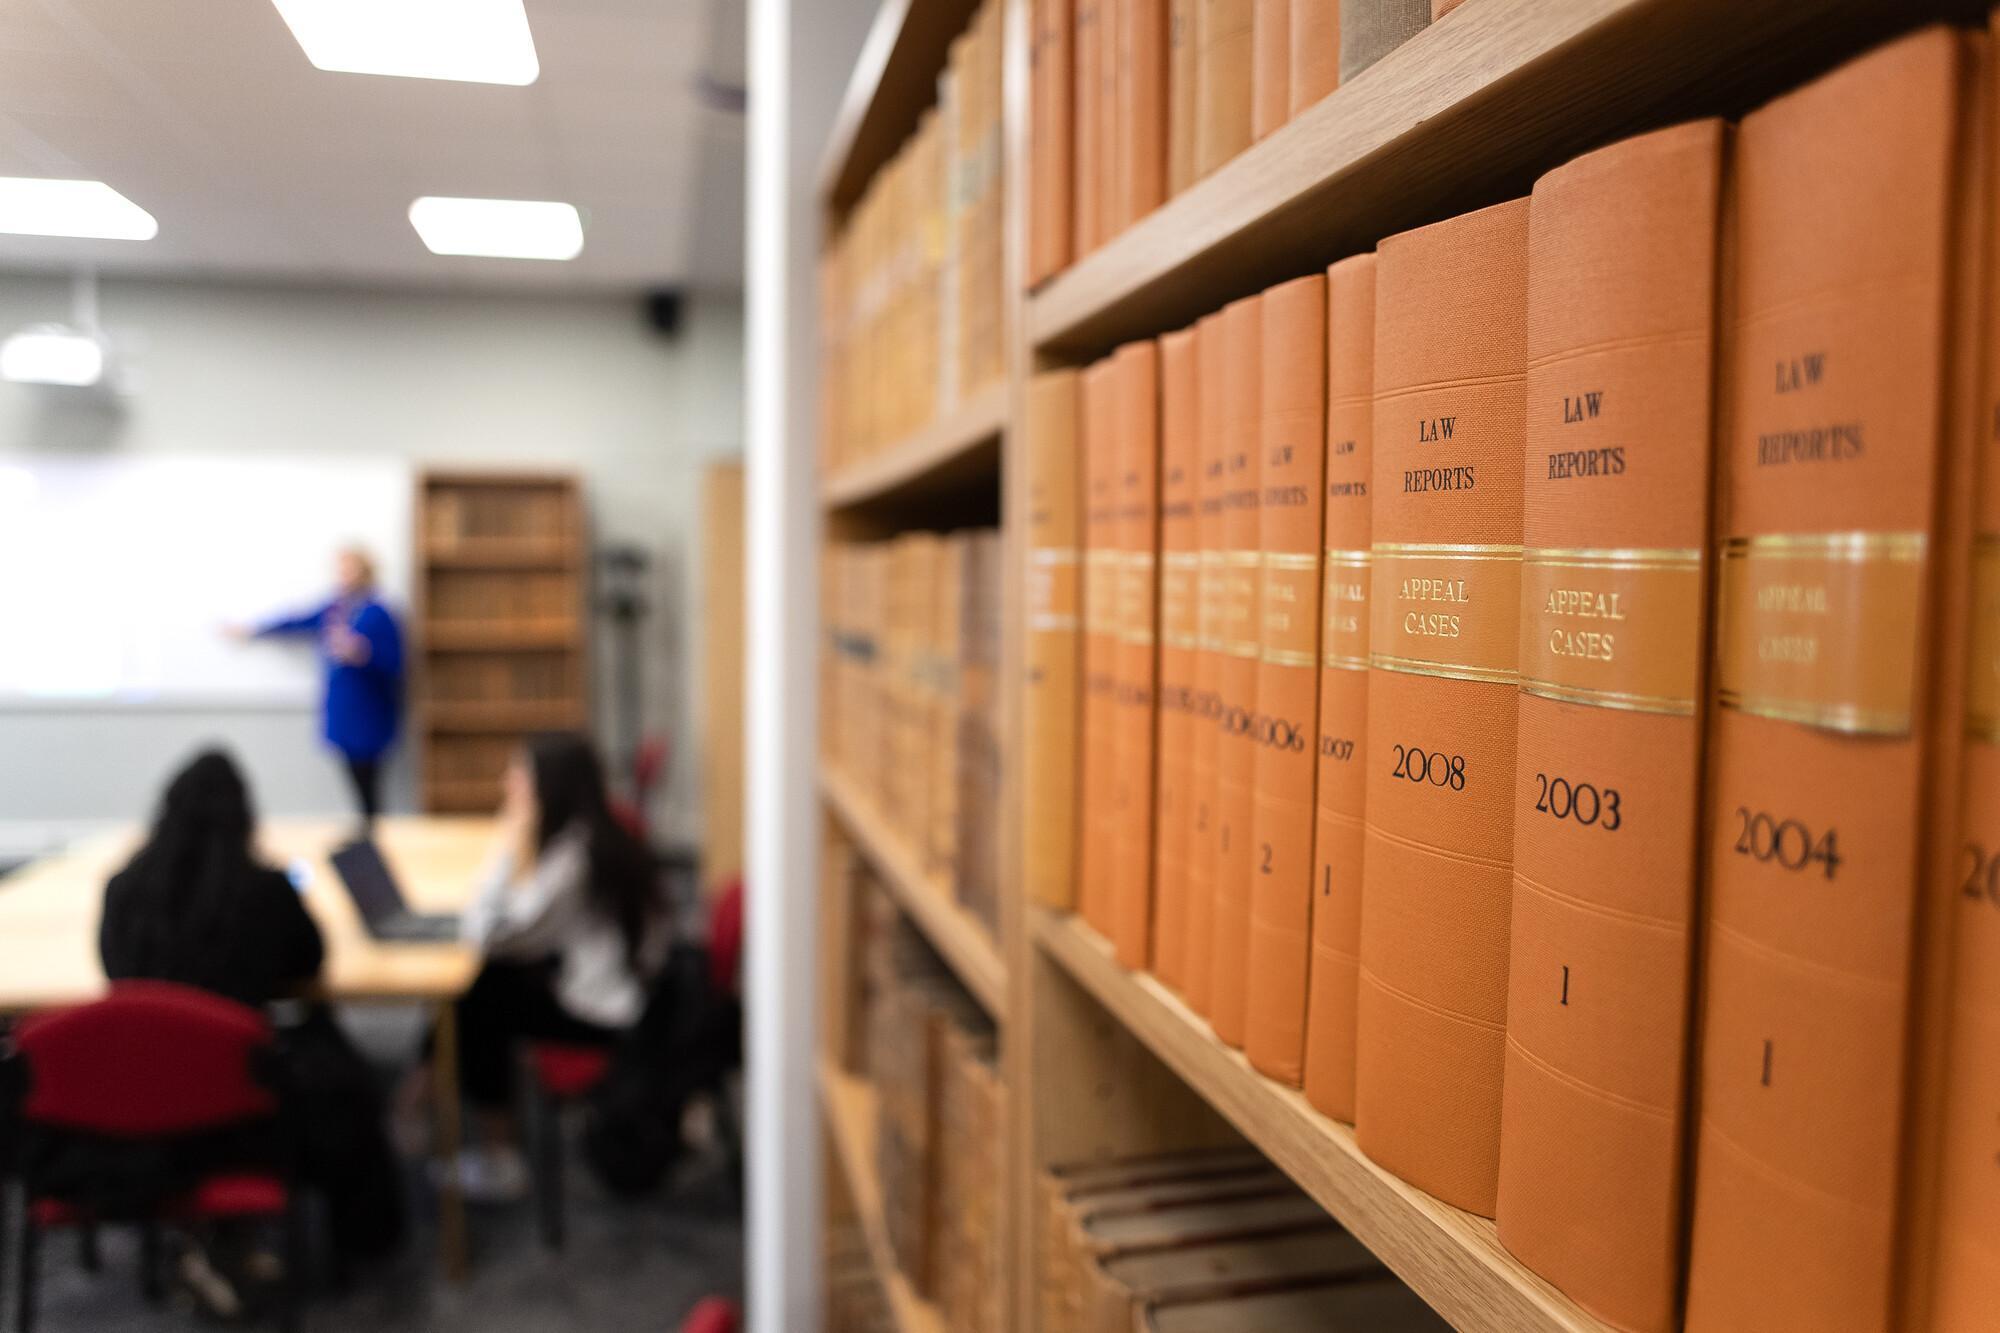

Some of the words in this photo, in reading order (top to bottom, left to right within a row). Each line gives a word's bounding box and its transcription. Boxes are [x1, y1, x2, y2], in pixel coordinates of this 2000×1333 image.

[1775, 353, 1825, 394] LAW
[1563, 391, 1604, 424] LAW
[1420, 417, 1457, 442] LAW
[1758, 423, 1865, 467] REPORTS
[1404, 466, 1475, 493] REPORTS
[1547, 447, 1626, 480] REPORTS
[1398, 578, 1470, 603] APPEAL
[1544, 589, 1626, 620] APPEAL
[1404, 612, 1461, 638] CASES
[1549, 628, 1615, 662] CASES
[1392, 744, 1466, 791] 2008
[1535, 773, 1622, 831] 2003
[1260, 842, 1273, 875] 2
[1734, 806, 1843, 881] 2004
[1560, 965, 1570, 1006] 1
[1760, 1038, 1774, 1087] 1
